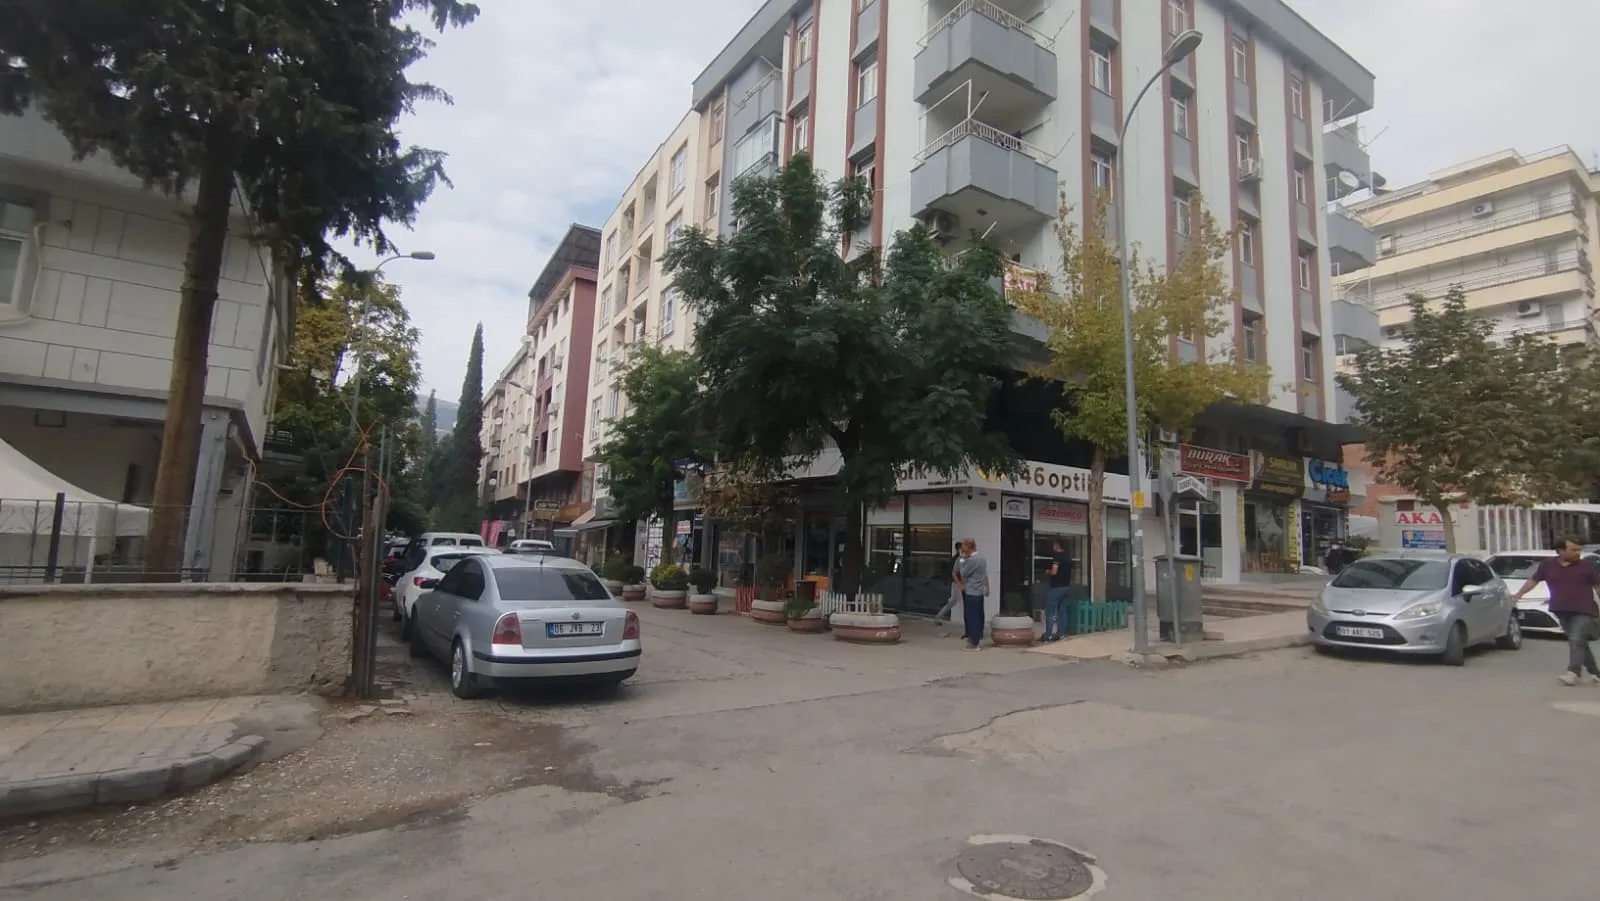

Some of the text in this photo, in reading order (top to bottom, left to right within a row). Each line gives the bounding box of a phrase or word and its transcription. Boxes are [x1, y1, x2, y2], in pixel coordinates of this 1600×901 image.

[1187, 448, 1232, 467] BURAK
[1049, 472, 1097, 494] opti
[1398, 511, 1457, 524] AKA
